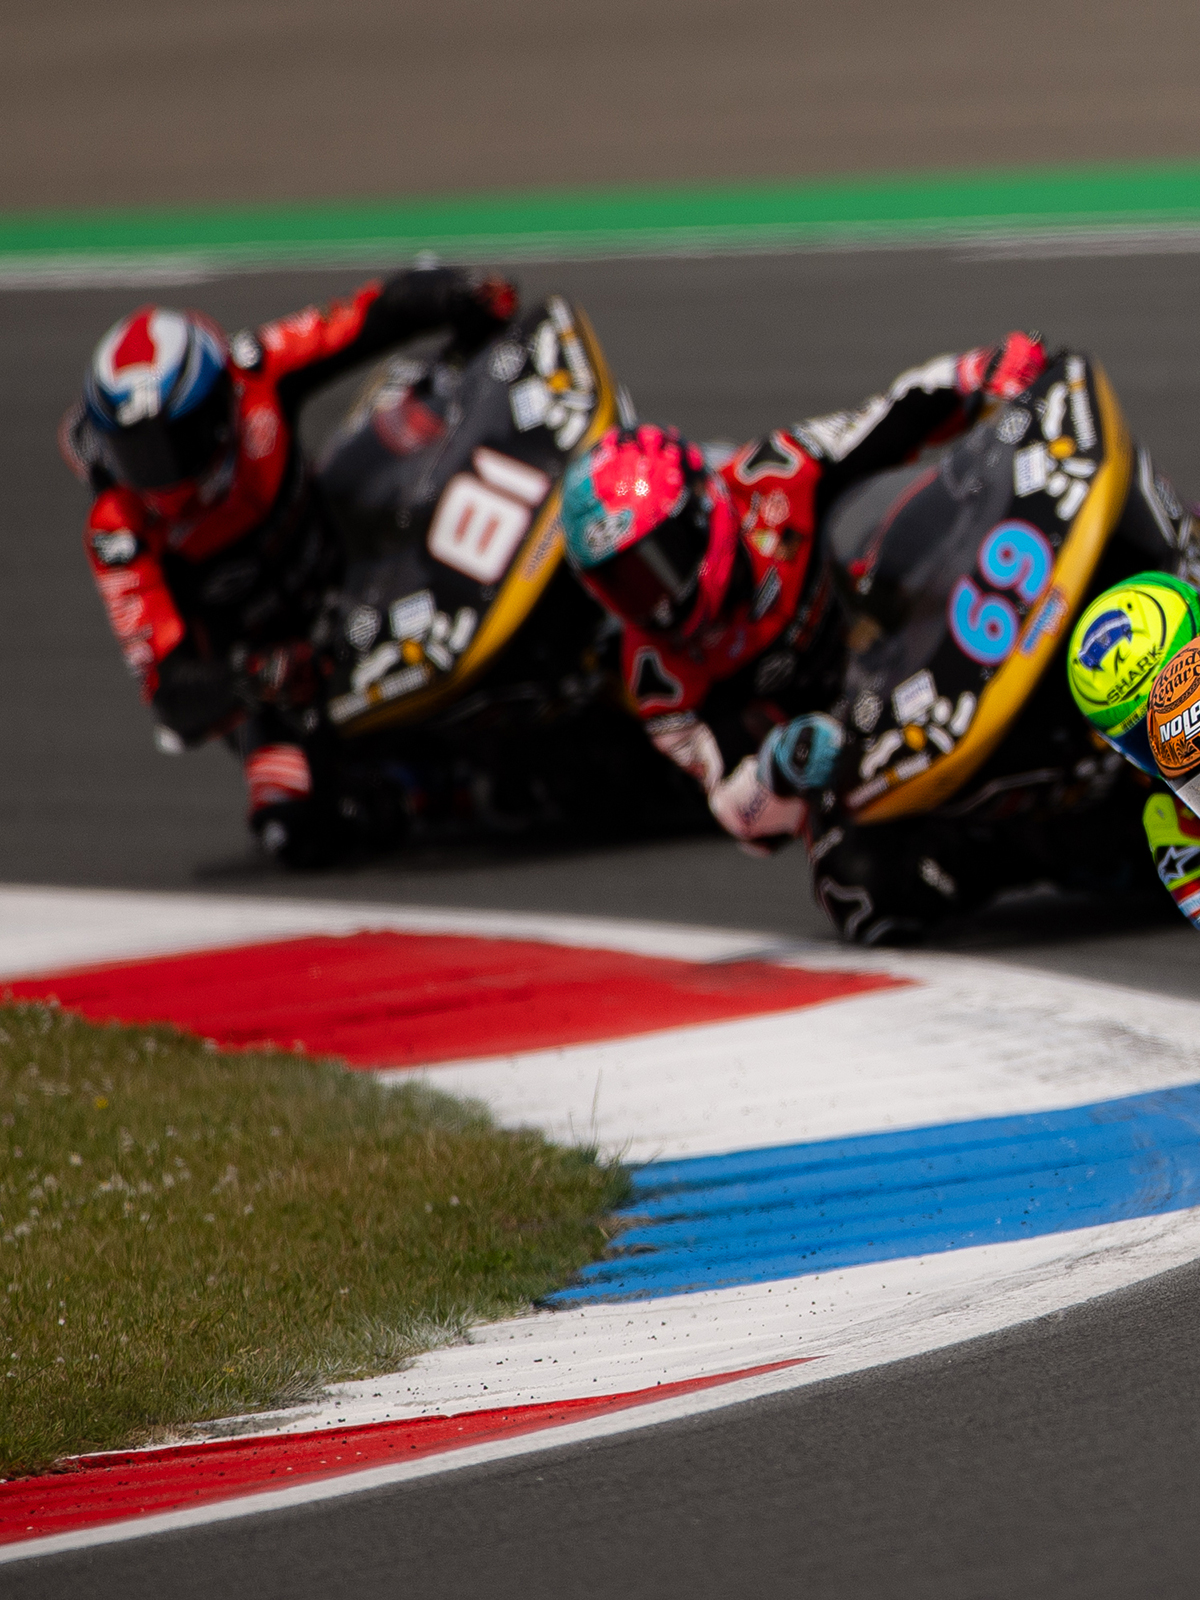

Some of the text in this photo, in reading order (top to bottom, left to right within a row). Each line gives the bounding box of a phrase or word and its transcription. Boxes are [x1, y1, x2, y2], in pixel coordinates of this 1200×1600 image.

[427, 447, 550, 584] 81
[949, 519, 1055, 666] 69
[1106, 646, 1163, 704] SHARK
